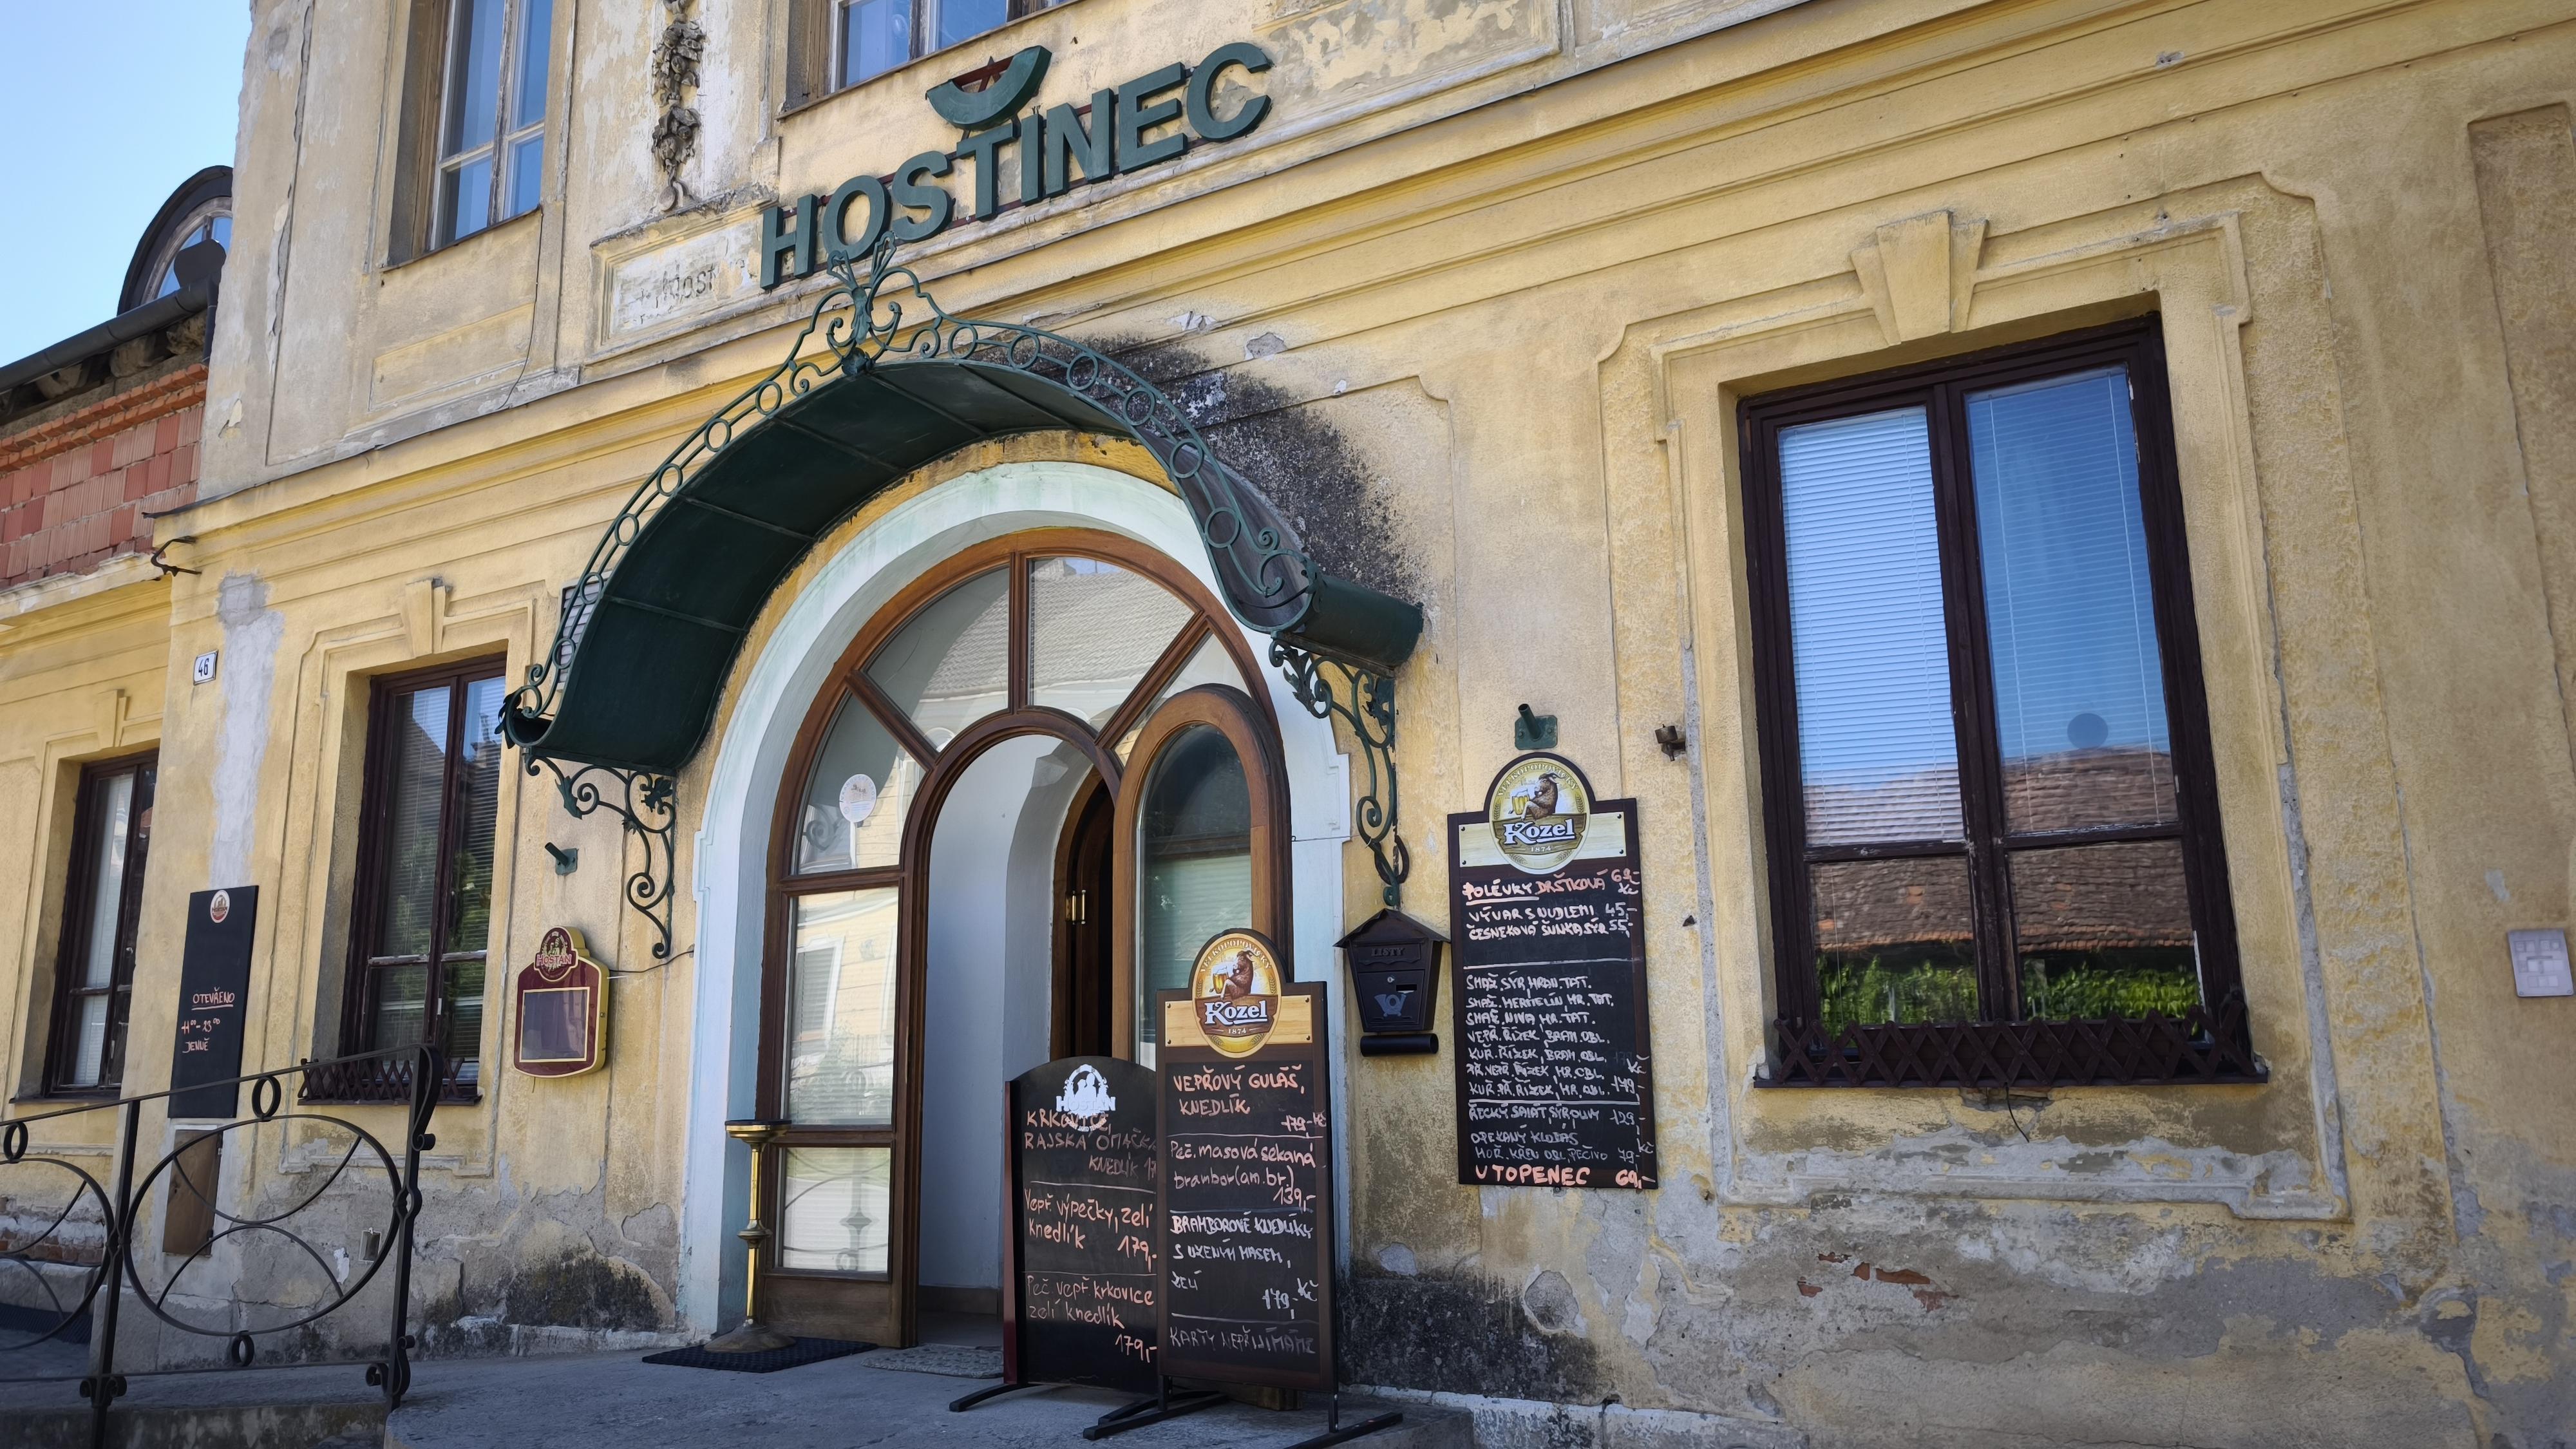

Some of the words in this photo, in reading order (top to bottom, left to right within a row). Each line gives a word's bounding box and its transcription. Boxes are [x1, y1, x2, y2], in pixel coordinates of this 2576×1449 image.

[760, 41, 1274, 292] HOSTINEC
[198, 658, 209, 676] 46
[1502, 818, 1576, 846] Kozel
[1462, 878, 1532, 900] POLÉVKY
[1535, 869, 1608, 895] DRŠTKOVÁ
[1468, 905, 1523, 922] VÝVAR
[1525, 908, 1535, 920] S
[1537, 904, 1594, 920] NUDLEMI
[1466, 920, 1539, 940] ČESNEKOVÁ
[536, 954, 573, 967] HOSTAN
[1371, 947, 1405, 957] LISTY
[193, 987, 235, 1005] OTEVŘENO
[1204, 999, 1269, 1026] Kozel
[1173, 1064, 1246, 1092] VEPŘOVÝ
[1248, 1063, 1305, 1094] GULÁŠ,
[1056, 1095, 1116, 1112] HOSTAN
[1179, 1093, 1251, 1116] KNEDLÍK
[1468, 1102, 1508, 1121] ŘECKÝ
[1025, 1131, 1093, 1151] RAJSKÁ
[1198, 1137, 1258, 1160] masová
[1261, 1142, 1316, 1168] sekaná
[1088, 1152, 1139, 1178] KNEDLÍK
[1475, 1164, 1591, 1186] UTOPENEC
[1024, 1188, 1053, 1215] Vepř.
[1121, 1203, 1153, 1229] zelí
[1170, 1211, 1252, 1235] BRAMBOROVÉ
[1254, 1213, 1314, 1239] KNEDLÍKY
[1173, 1244, 1184, 1259] S
[1187, 1238, 1236, 1262] UZENÝM
[1028, 1298, 1061, 1320] zelí
[1066, 1302, 1125, 1329] knedlík
[1170, 1327, 1216, 1351] KARTY
[1221, 1325, 1316, 1355] NEPŘIJÍMÁME
